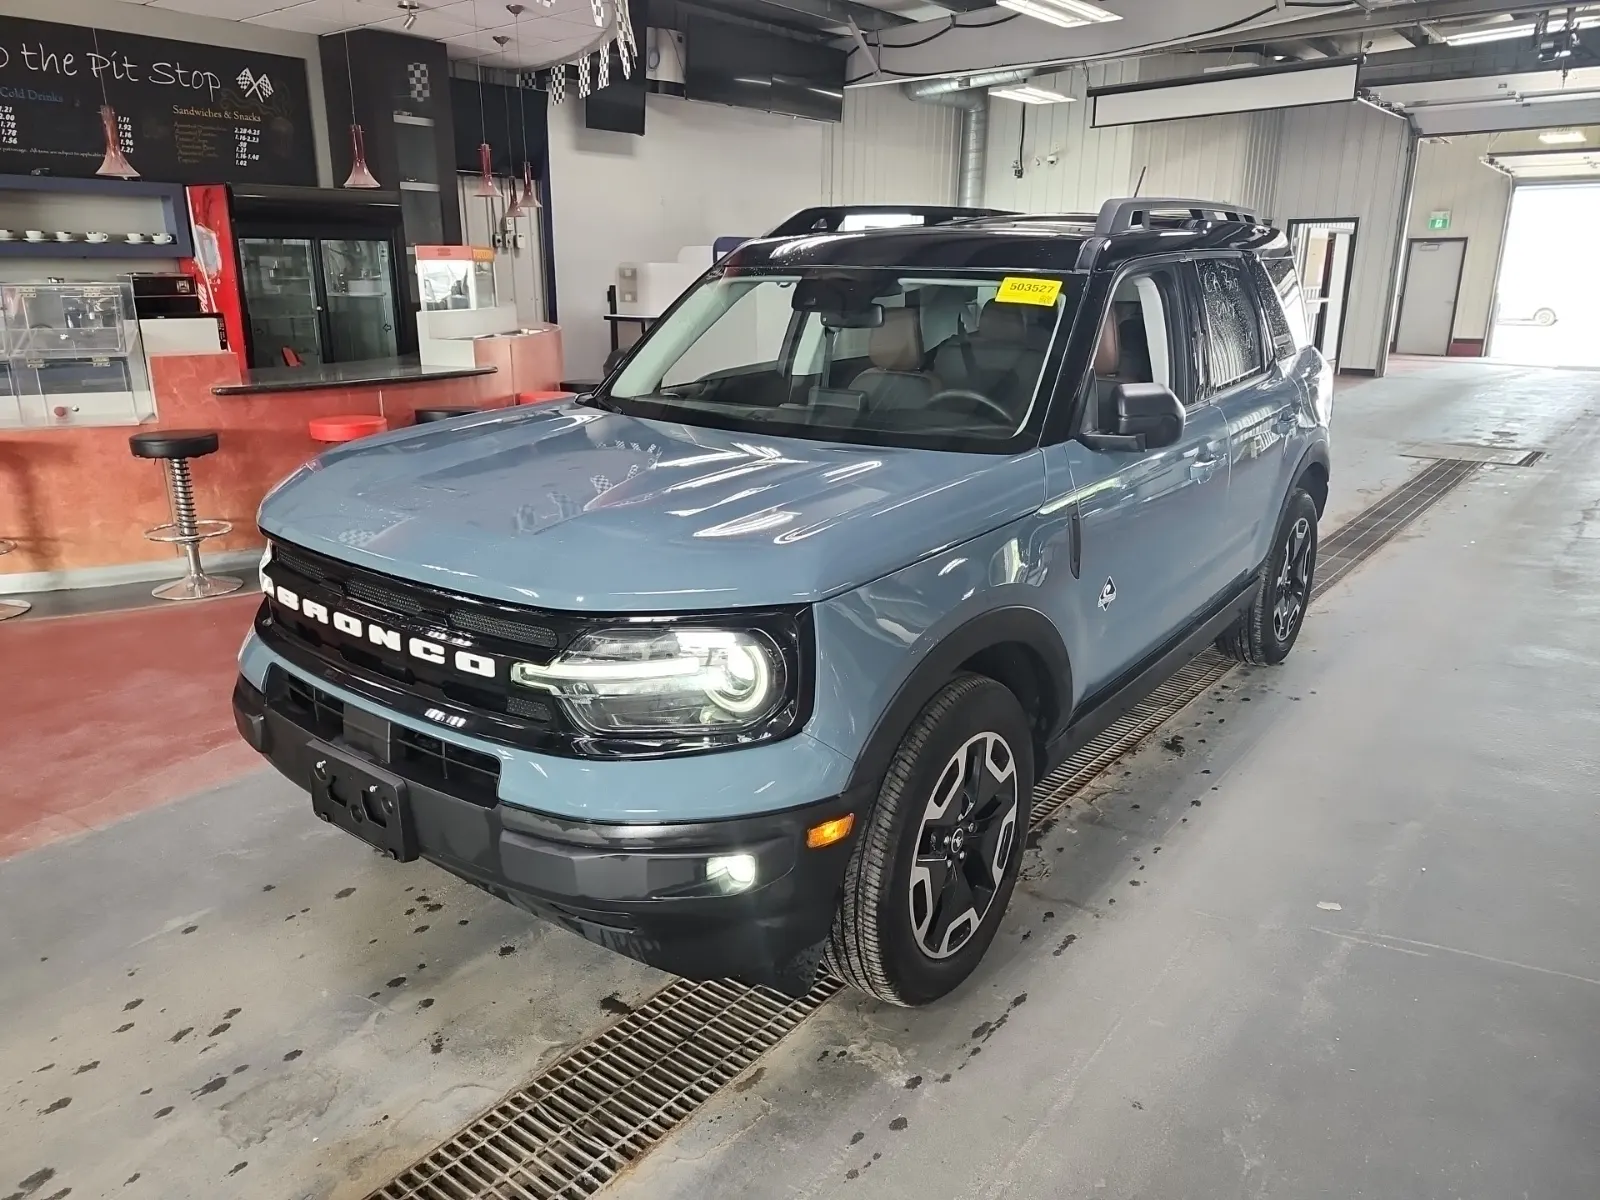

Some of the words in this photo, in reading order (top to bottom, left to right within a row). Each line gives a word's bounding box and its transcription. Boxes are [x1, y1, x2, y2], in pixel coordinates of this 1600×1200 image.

[21, 43, 77, 75] the
[86, 50, 139, 81] Pit
[148, 61, 221, 102] Stop
[0, 87, 25, 99] Cold
[28, 89, 63, 102] Drinks
[172, 105, 222, 118] Sandwiches
[223, 110, 232, 119] &
[233, 111, 261, 122] Snacks
[1009, 282, 1055, 294] 503527
[277, 585, 496, 678] BRONCO
